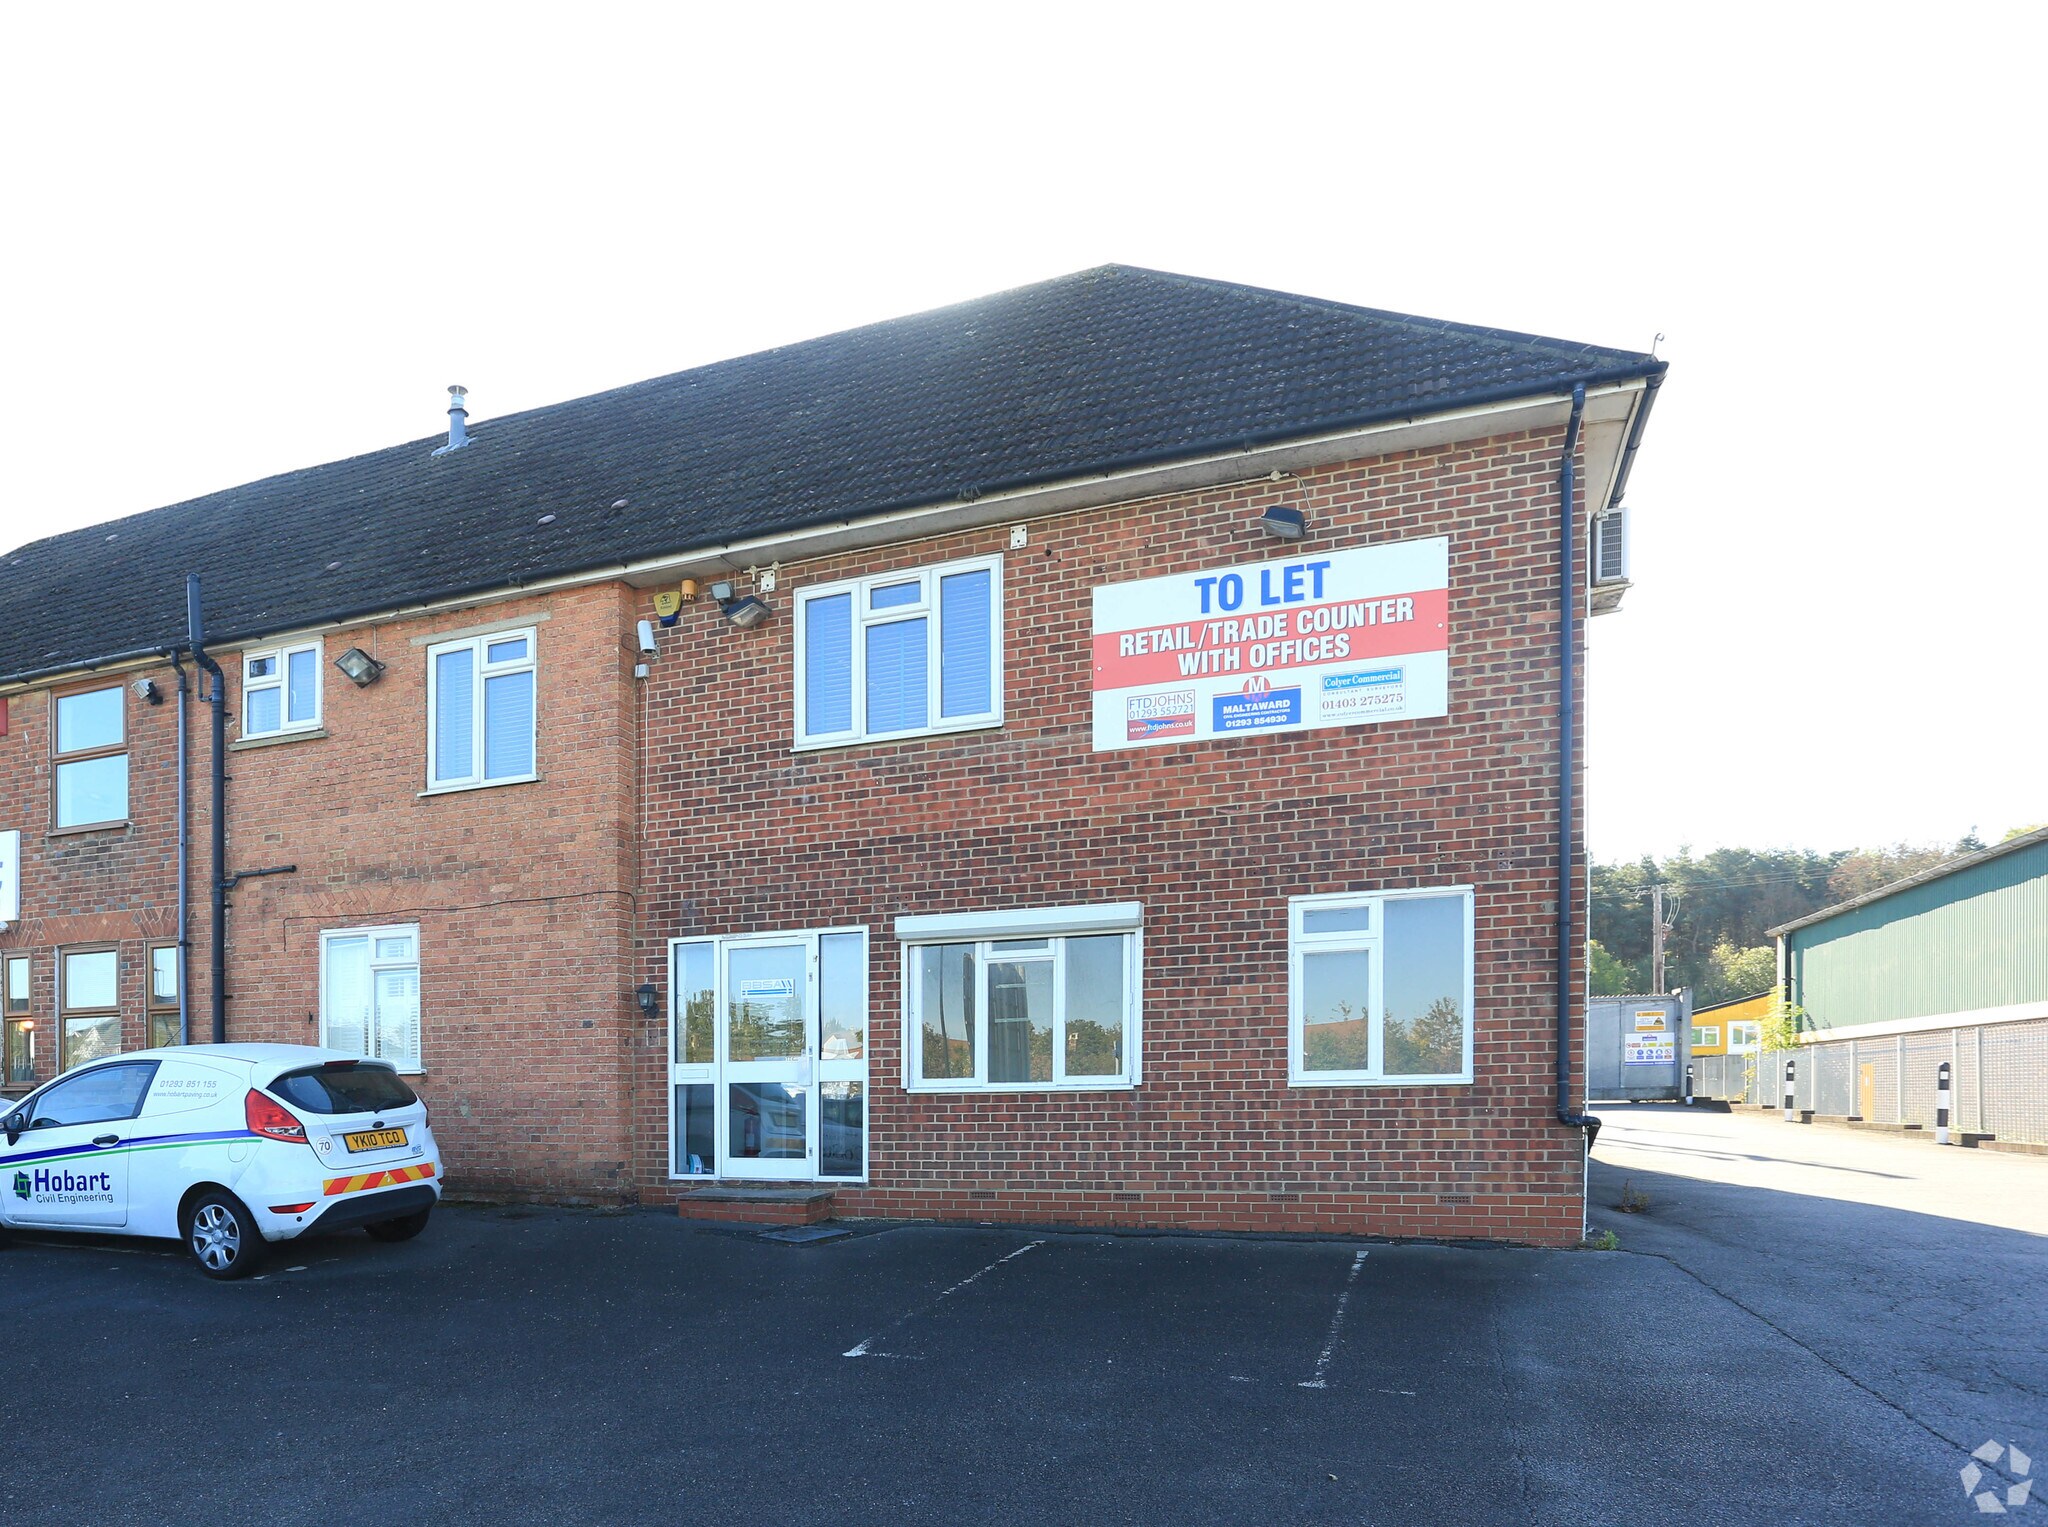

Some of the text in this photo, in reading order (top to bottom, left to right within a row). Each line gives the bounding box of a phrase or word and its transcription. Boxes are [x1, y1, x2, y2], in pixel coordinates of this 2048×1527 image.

[1194, 560, 1331, 614] TO LET
[1296, 597, 1414, 634] COUNTER
[1177, 633, 1351, 677] WITH OFFICES
[1325, 670, 1401, 688] Colyer Commercial
[1223, 699, 1290, 715] MALTAWARD
[1322, 693, 1403, 710] 01403 275275
[1129, 704, 1193, 719] 01293 552721
[1129, 720, 1193, 733] www.ftdjohns.co.uk
[1225, 715, 1287, 728] 01293 854930
[160, 1080, 217, 1088] 01293 851 155
[153, 1091, 218, 1099] www.hobartpaving.co.uk
[318, 1141, 331, 1151] 70
[352, 1131, 400, 1148] YK10 TCO
[34, 1168, 111, 1192] Hobart
[36, 1192, 113, 1204] Civil Engineering
